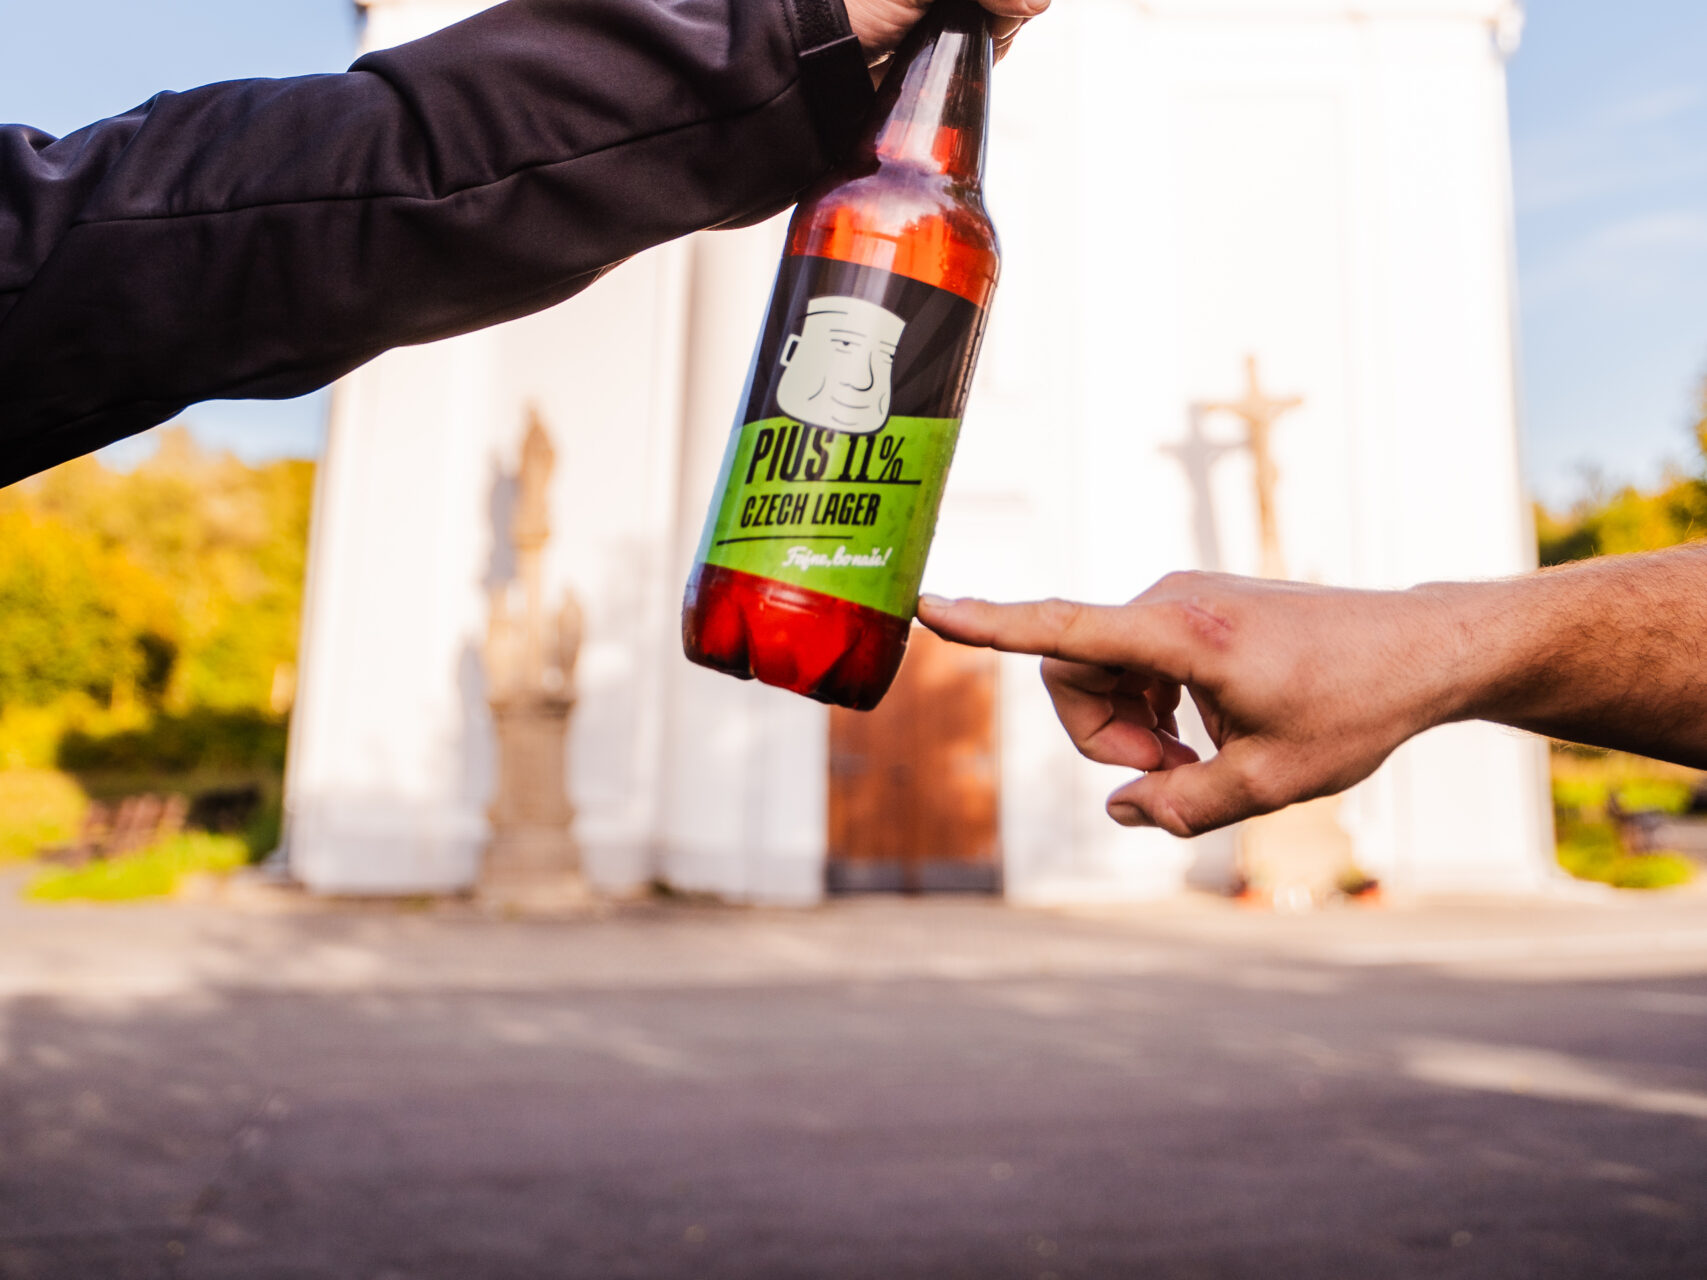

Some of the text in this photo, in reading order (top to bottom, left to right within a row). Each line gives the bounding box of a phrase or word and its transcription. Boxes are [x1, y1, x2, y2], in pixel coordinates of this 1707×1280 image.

[745, 424, 905, 484] PIUS 11%
[740, 493, 881, 528] CZECH LAGER
